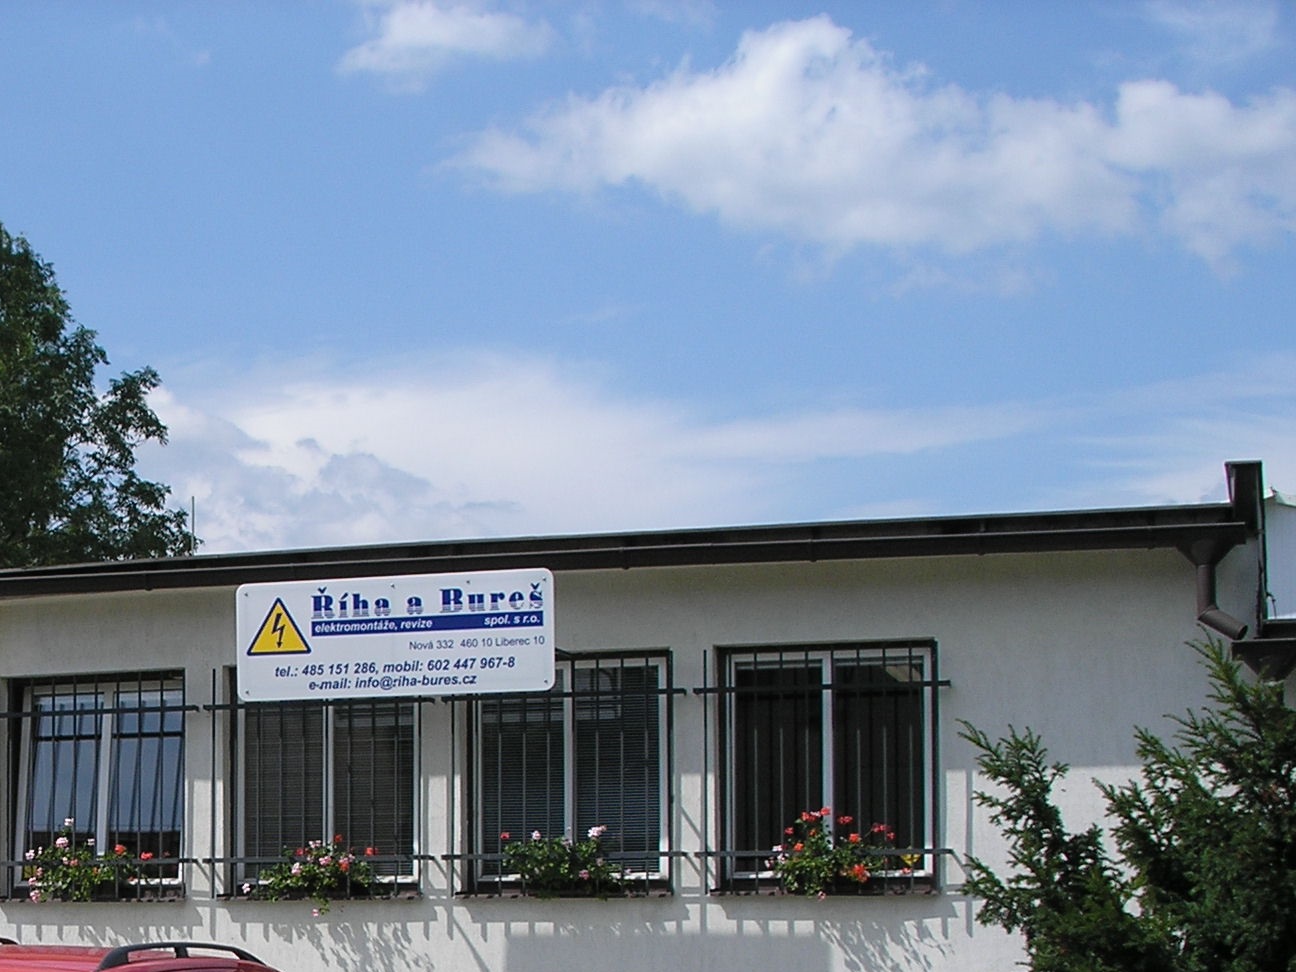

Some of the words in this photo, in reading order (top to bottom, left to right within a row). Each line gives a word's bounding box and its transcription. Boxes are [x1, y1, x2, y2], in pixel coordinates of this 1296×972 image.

[311, 586, 392, 619] Říha
[406, 596, 424, 615] a
[439, 582, 543, 613] Bureš
[314, 619, 398, 634] elektromontáže,
[400, 618, 433, 630] revize
[484, 615, 511, 628] spol.
[513, 615, 521, 624] s
[523, 614, 541, 624] r.o.
[409, 639, 434, 650] Nová
[436, 639, 454, 649] 332
[460, 638, 478, 648] 460
[482, 637, 493, 647] 10
[495, 636, 530, 647] Liberec
[534, 635, 545, 645] 10
[275, 666, 299, 678] tel.:
[302, 664, 324, 676] 485
[329, 663, 349, 675] 151
[354, 662, 379, 675] 286,
[383, 660, 423, 673] mobil:
[427, 659, 450, 671] 602
[454, 658, 476, 669] 447
[480, 656, 515, 669] 967-8
[309, 678, 352, 691] e-mail:
[355, 674, 478, 691] info@riha-bures.cz
